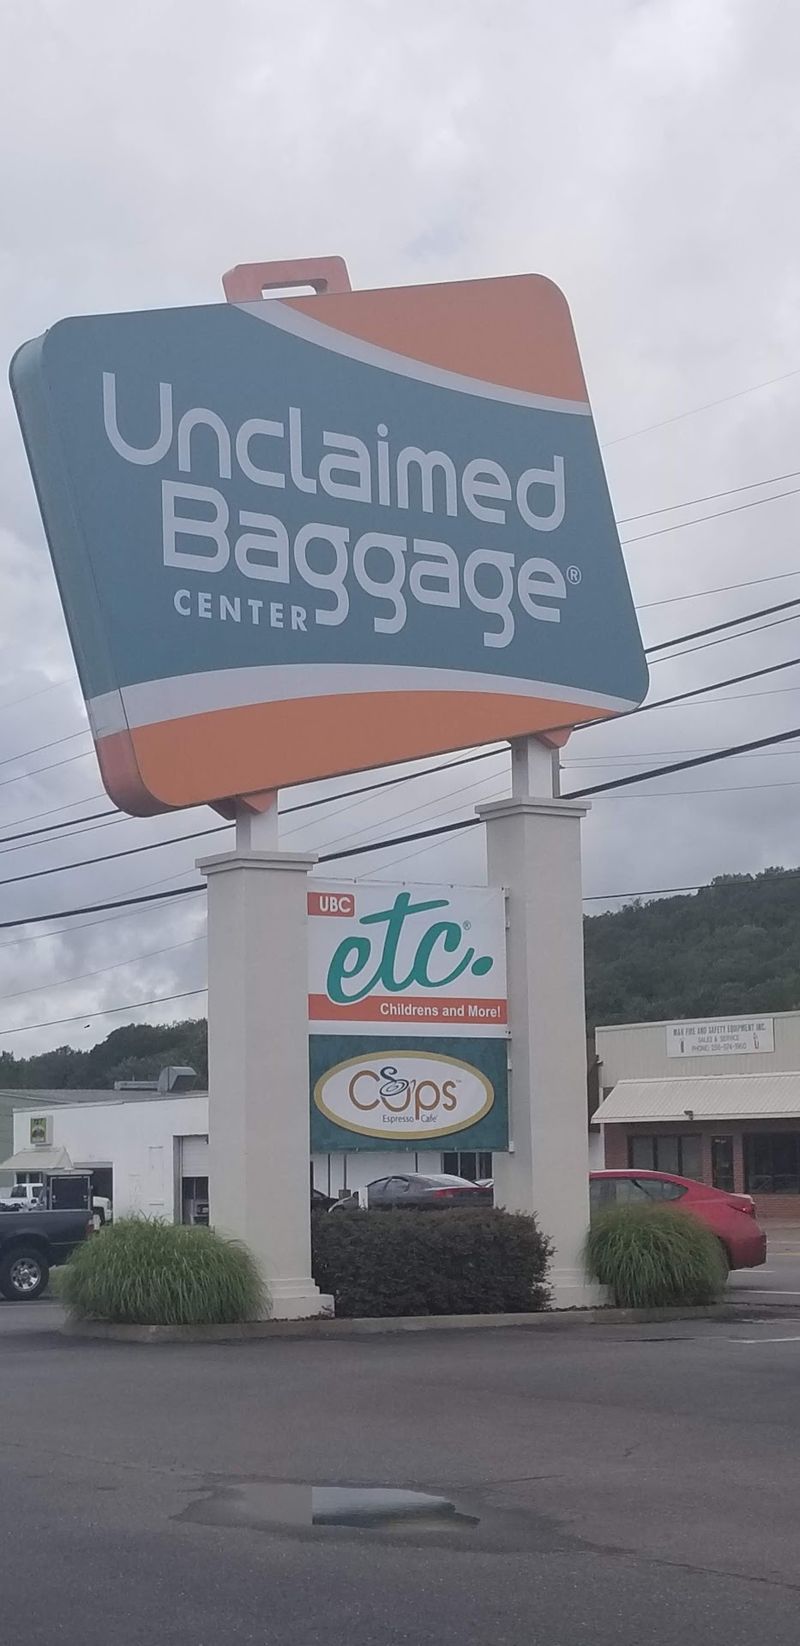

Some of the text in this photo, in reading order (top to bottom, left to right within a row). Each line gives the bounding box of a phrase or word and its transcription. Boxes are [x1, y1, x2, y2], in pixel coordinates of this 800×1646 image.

[102, 371, 566, 531] Unclaimed
[161, 479, 568, 648] Baggage
[173, 588, 308, 632] CENTER
[319, 895, 351, 913] UBC
[380, 1002, 501, 1018] Childrens and More!
[697, 1026, 707, 1035] AND
[708, 1024, 725, 1034] SAFETY
[349, 1069, 457, 1121] Cups
[382, 1114, 415, 1125] Espresso
